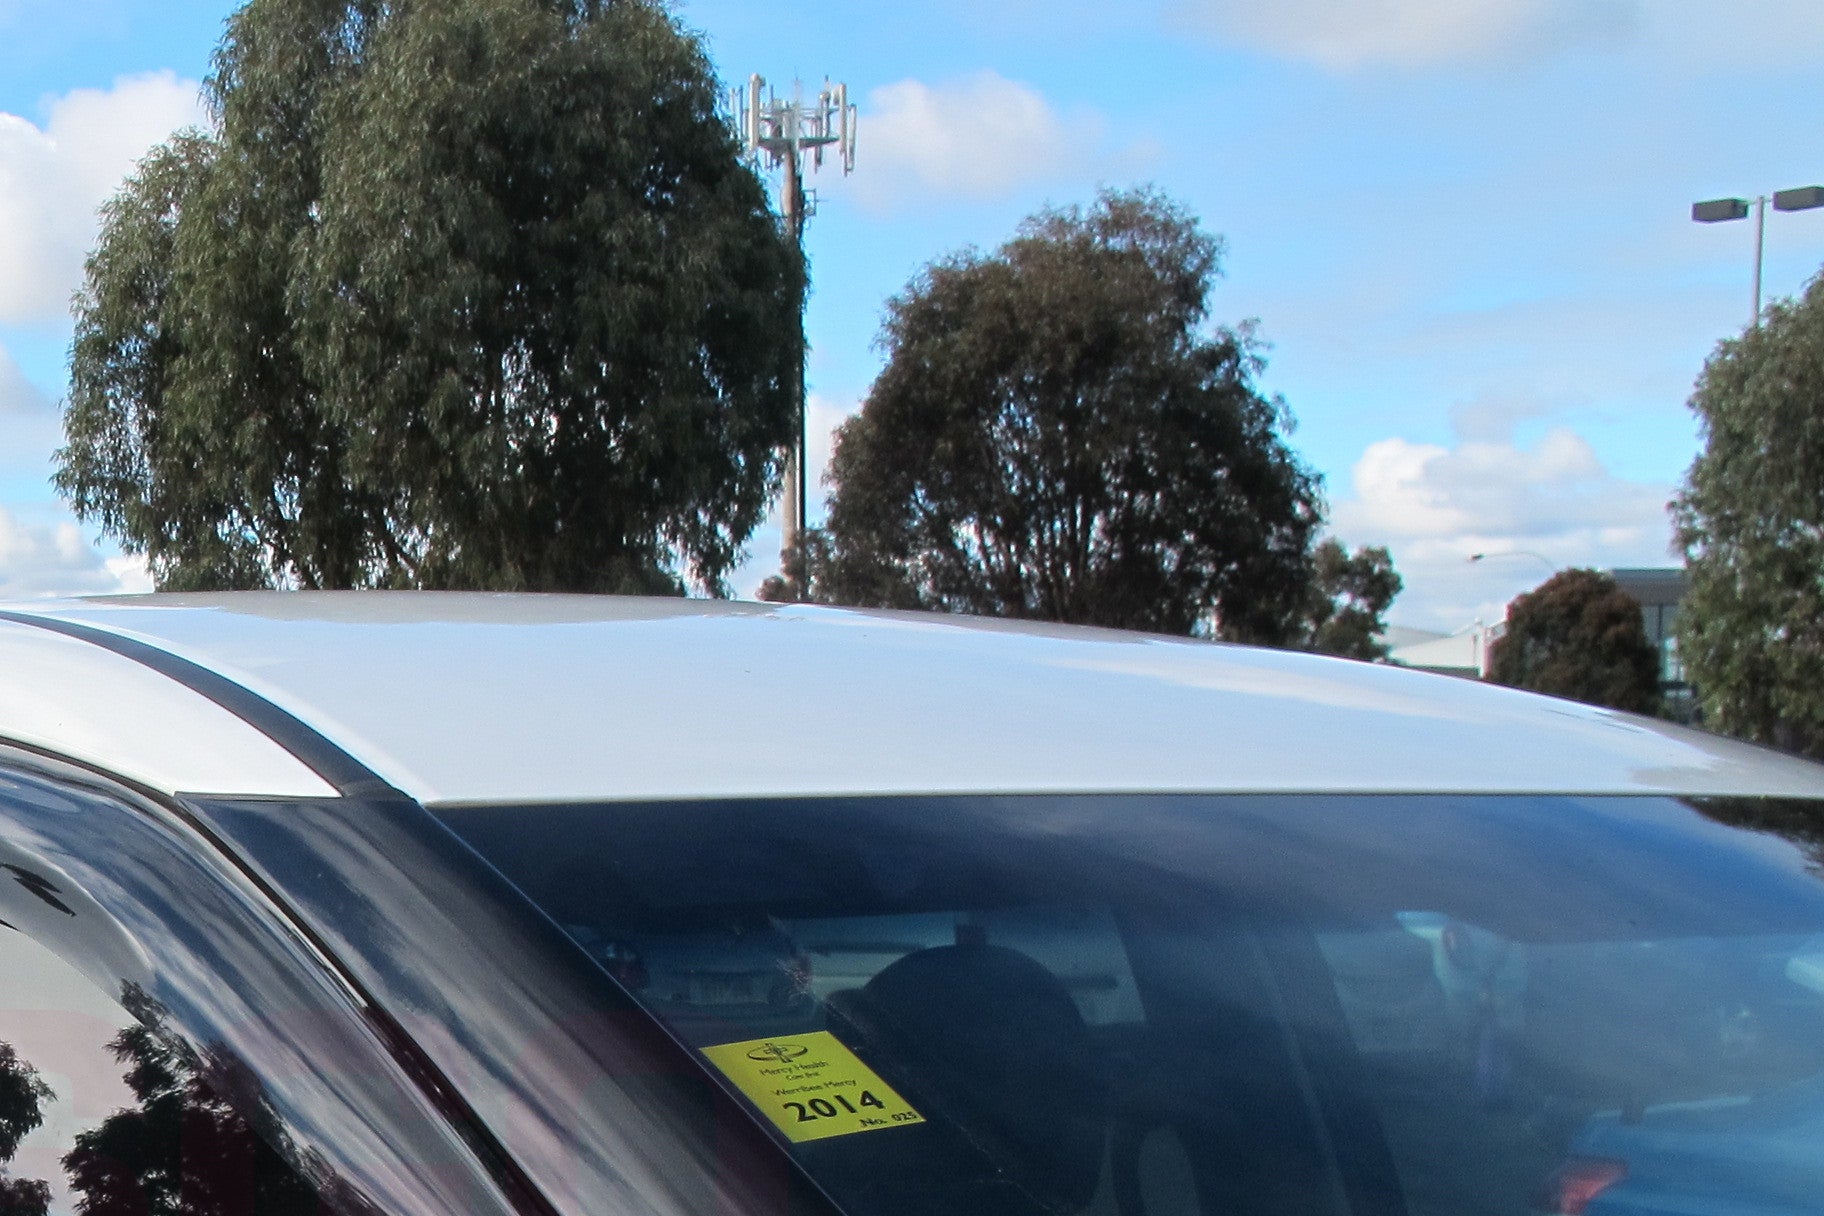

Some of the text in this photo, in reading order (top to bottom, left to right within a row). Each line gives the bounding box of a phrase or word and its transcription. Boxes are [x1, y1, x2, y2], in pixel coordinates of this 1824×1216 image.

[759, 1060, 830, 1076] Mercy Health
[824, 1079, 856, 1088] Mercy
[782, 1090, 885, 1123] 2014
